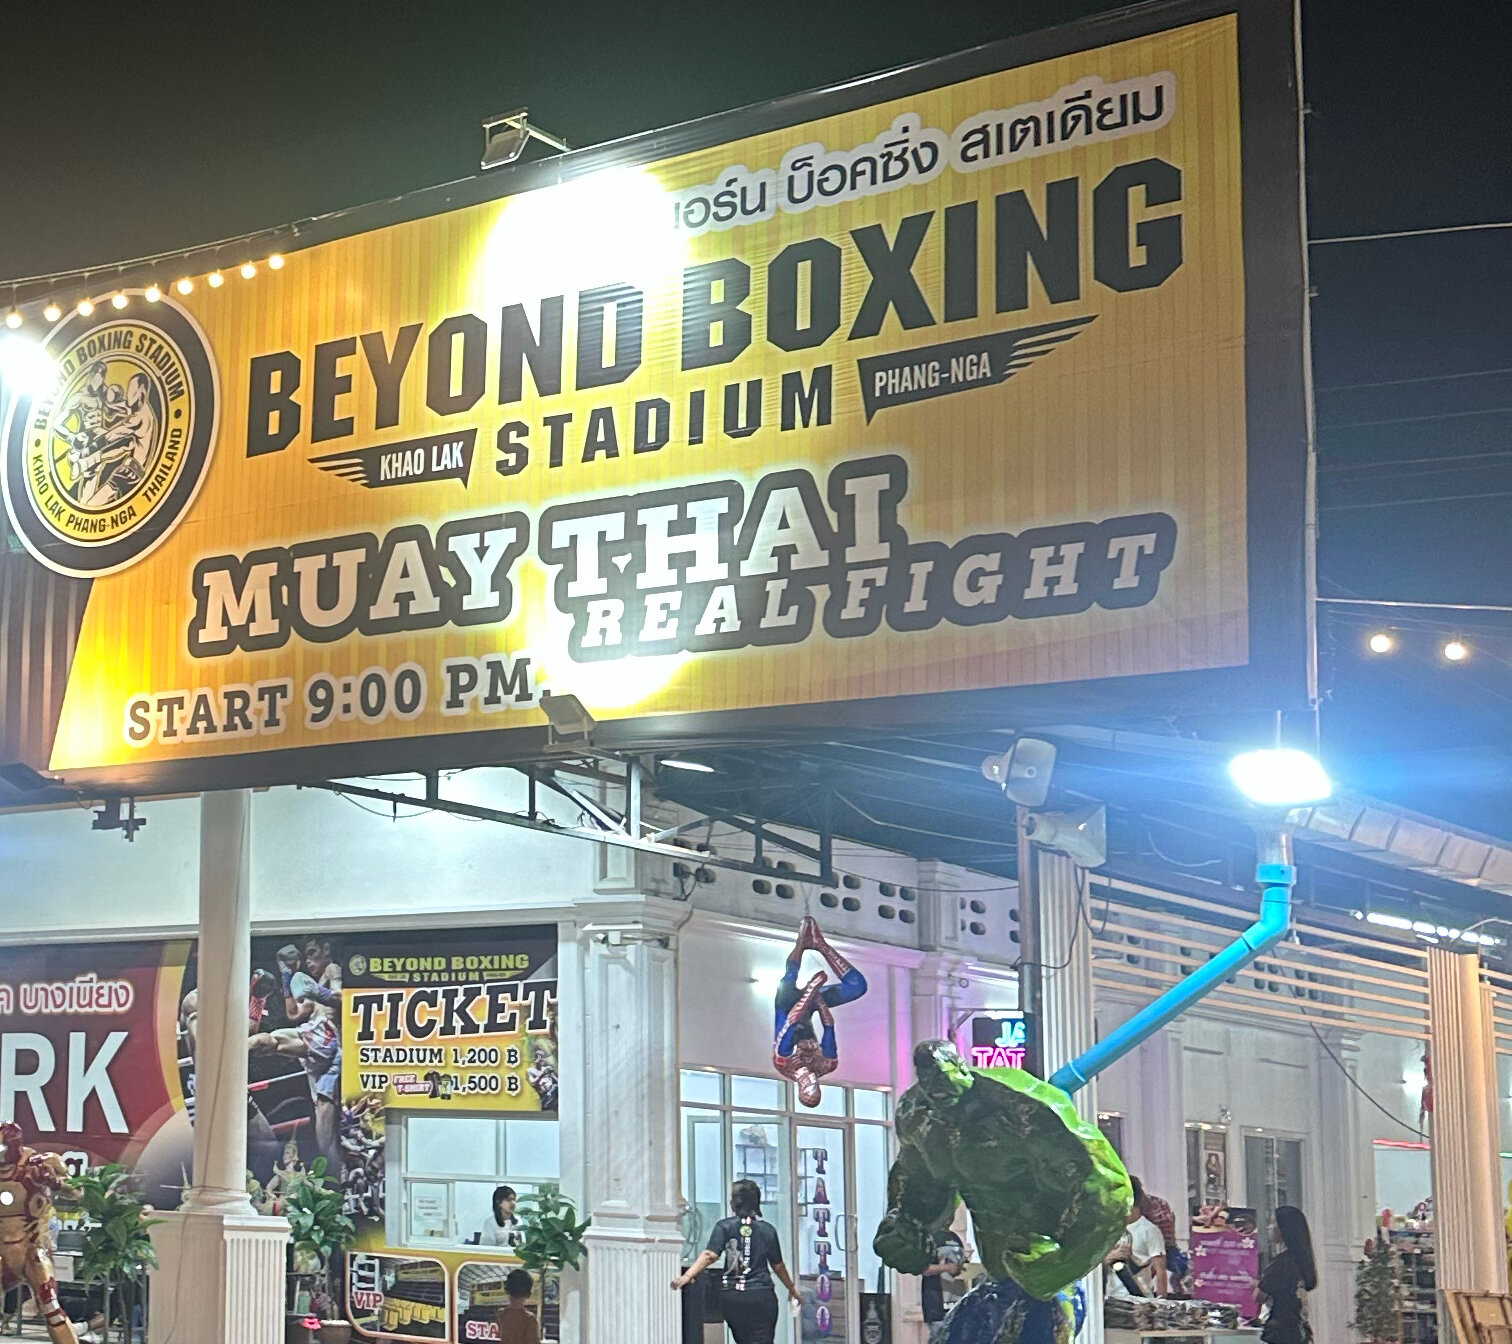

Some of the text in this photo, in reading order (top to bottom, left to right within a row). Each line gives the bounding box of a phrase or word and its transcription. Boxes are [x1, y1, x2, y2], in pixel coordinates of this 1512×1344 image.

[674, 177, 768, 230] อร์น
[960, 84, 1165, 164] สเตเดียม
[245, 157, 1183, 459] BEYOND BOXING
[77, 330, 132, 363] BOXING
[135, 333, 186, 403] STADIUM
[874, 353, 992, 398] PHANG-NGA
[495, 364, 833, 477] STADIUM
[32, 428, 183, 534] KHAO LAK PHANG-NGA THAILAND
[379, 441, 465, 482] KHAO LAK
[197, 472, 891, 645] MUAY THAI
[580, 532, 1157, 649] REAL FIGHT
[128, 683, 289, 742] START
[307, 668, 422, 723] 9:00
[20, 973, 134, 1013] บางเนียง
[369, 953, 529, 972] BEYOND BOXING
[412, 971, 480, 983] STADIUM
[352, 980, 558, 1042] TICKET
[359, 1047, 444, 1064] STADIUM
[452, 1047, 499, 1066] 1,200
[359, 1073, 389, 1090] VIP
[452, 1073, 499, 1092] 1,500
[971, 1046, 1026, 1070] TAT
[813, 1147, 832, 1333] TATTOO
[353, 1291, 384, 1309] VIP
